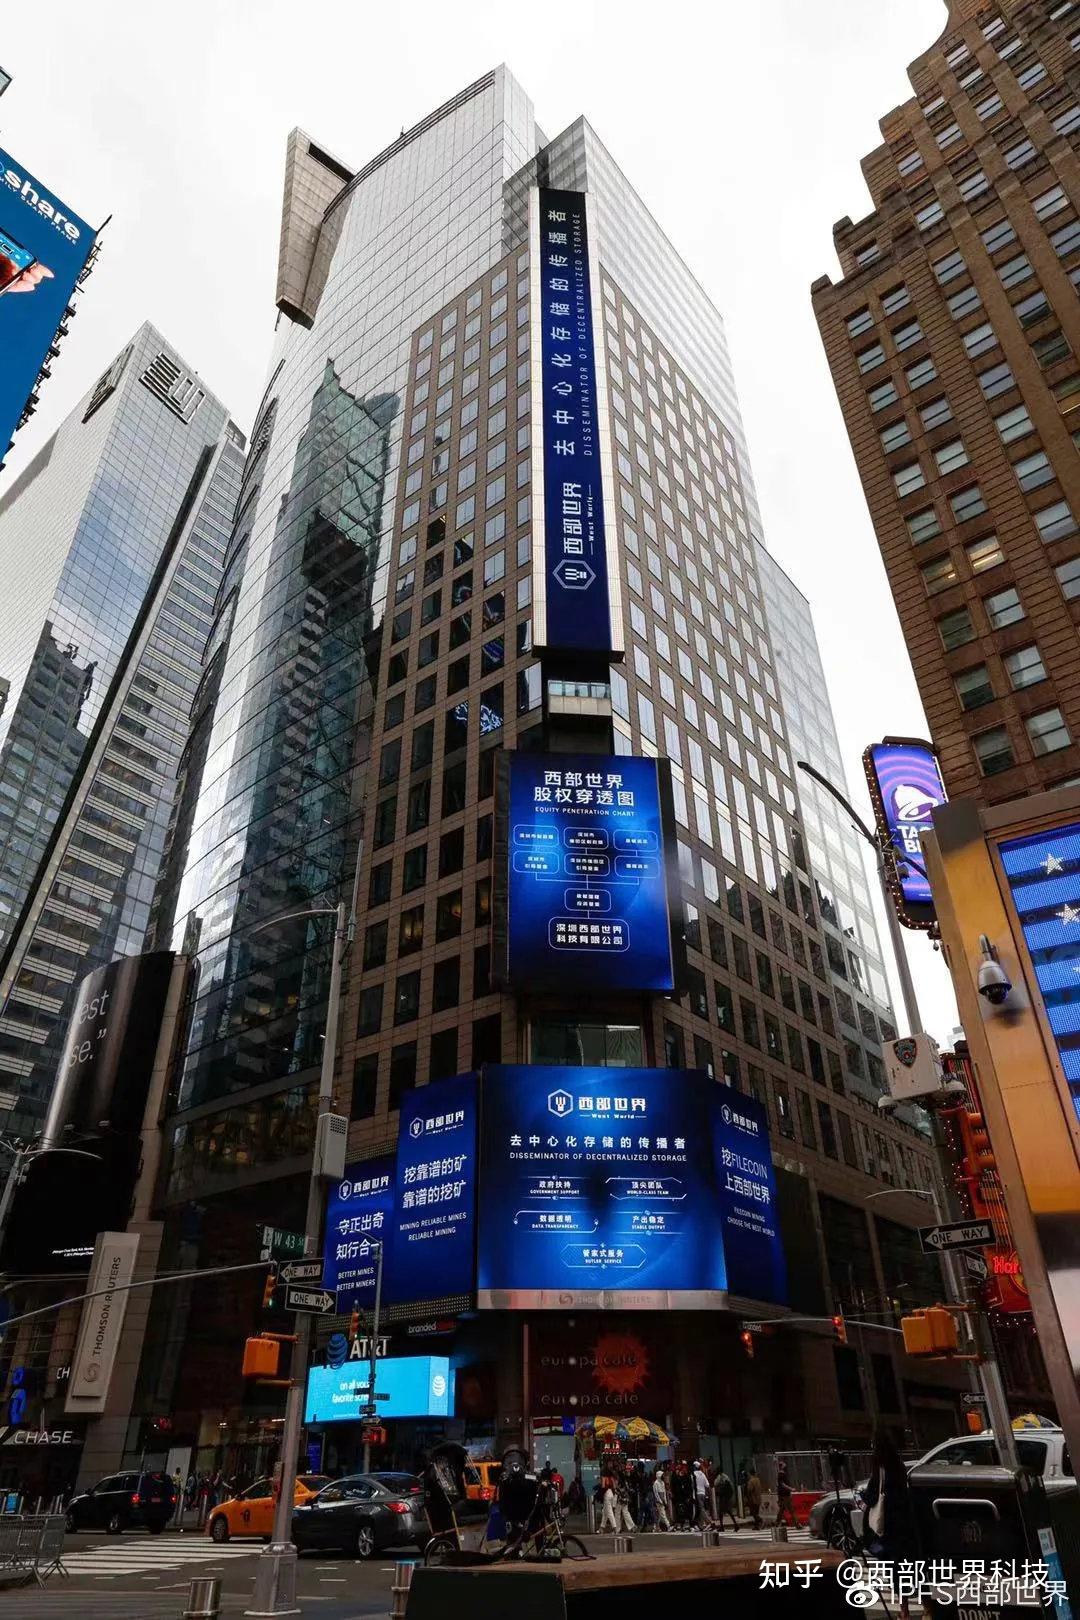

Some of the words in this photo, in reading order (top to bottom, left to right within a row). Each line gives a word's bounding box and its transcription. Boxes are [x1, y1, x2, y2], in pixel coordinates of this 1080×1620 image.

[573, 213, 582, 254] STORAGE
[575, 260, 586, 340] DECENTRALIZED
[548, 210, 576, 456] 去中心化存储的传播者
[579, 347, 587, 360] OF
[580, 367, 593, 456] DISSEMINATOR
[544, 770, 624, 789] 西部世界
[534, 786, 634, 806] 股权穿透图
[562, 808, 610, 816] PENETRATION
[578, 1096, 647, 1112] 西部世界
[510, 1134, 686, 1149] 去中心化存储的传播者
[509, 1152, 570, 1160] DISSEMINATOR
[586, 1153, 649, 1161] DECENTRALIZED
[651, 1154, 687, 1162] STORAGE
[403, 1154, 468, 1184] 挖靠谱的矿
[402, 1179, 467, 1209] 靠谱的挖矿
[725, 1171, 770, 1204] 上西部世界
[338, 1211, 384, 1235] 守正出奇
[399, 1221, 420, 1231] MINING
[420, 1215, 447, 1227] RELIABLE
[448, 1211, 467, 1222] MINES
[274, 1231, 282, 1246] W
[285, 1234, 296, 1249] 43
[408, 1230, 434, 1241] RELIABLE
[434, 1226, 457, 1237] MINING
[931, 1231, 953, 1245] ONE
[961, 1227, 984, 1239] WAY
[336, 1238, 380, 1260] 知行合一
[284, 1266, 297, 1278] ONE
[303, 1266, 318, 1276] WAY
[338, 1269, 356, 1280] BETTER
[357, 1266, 375, 1276] MINES
[336, 1281, 355, 1292] BETTER
[355, 1278, 376, 1289] MINERS
[92, 1304, 111, 1357] THOMSON
[104, 1256, 121, 1302] RUTERS
[294, 1293, 309, 1304] ONE
[315, 1296, 330, 1307] WAY
[14, 1430, 73, 1444] CHASE
